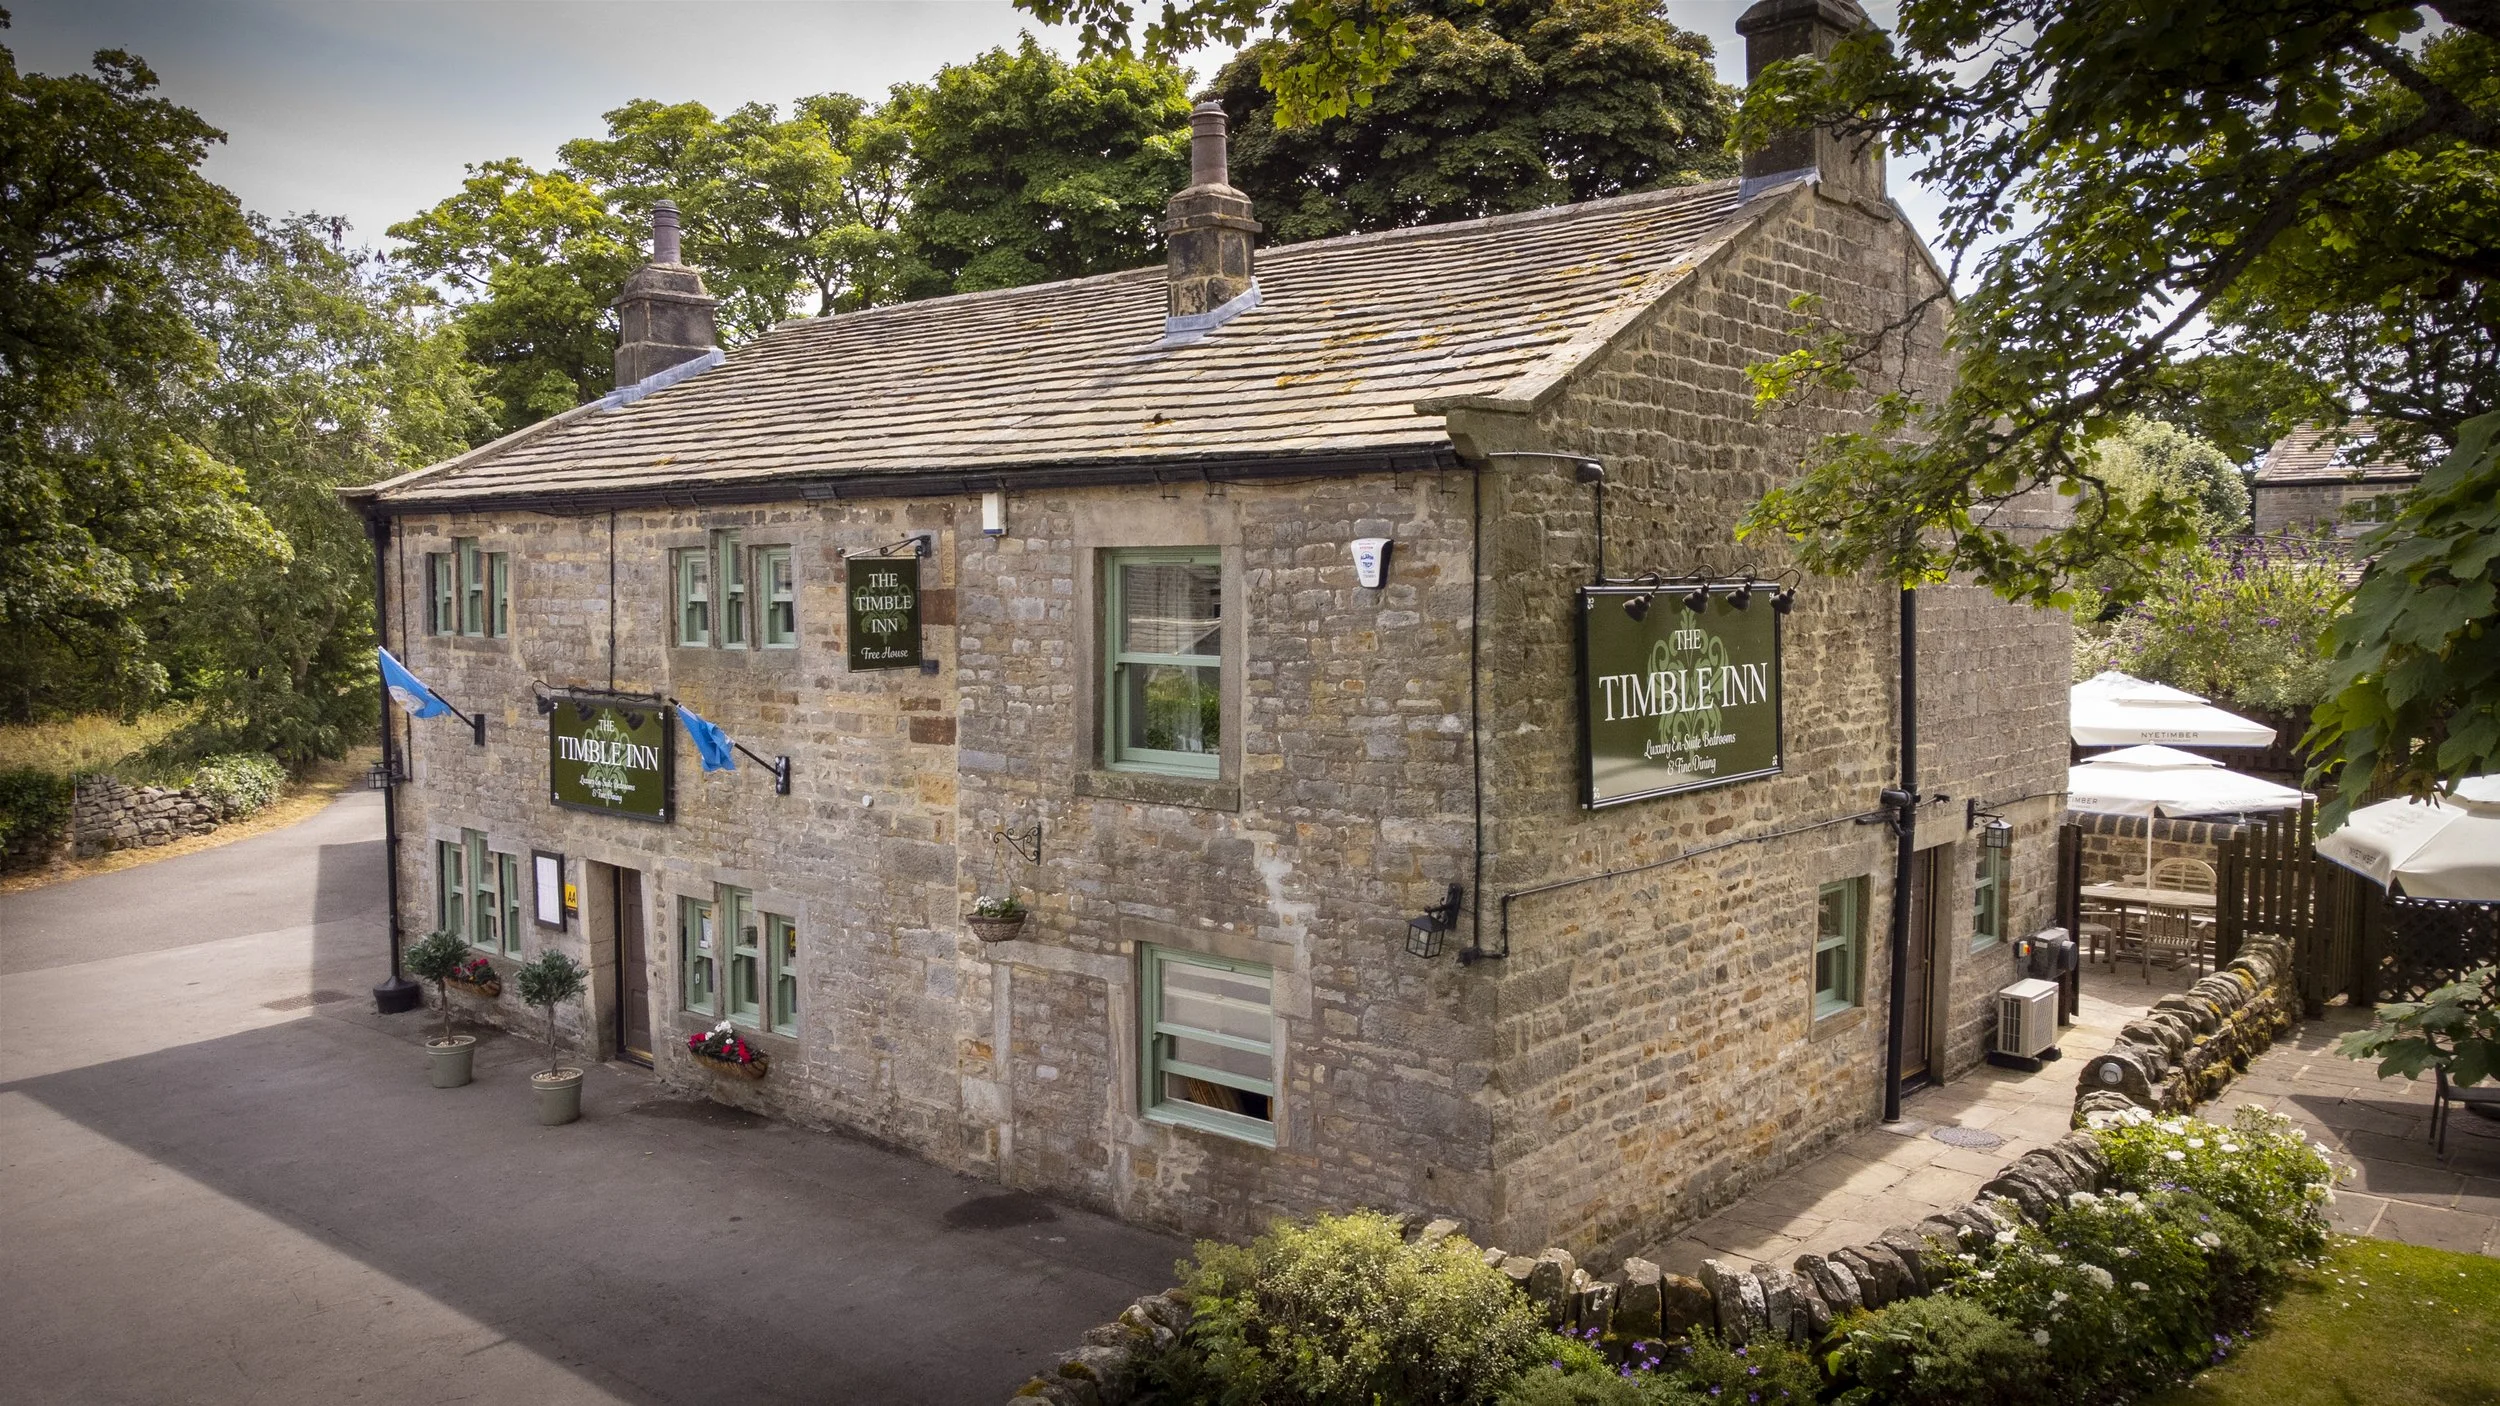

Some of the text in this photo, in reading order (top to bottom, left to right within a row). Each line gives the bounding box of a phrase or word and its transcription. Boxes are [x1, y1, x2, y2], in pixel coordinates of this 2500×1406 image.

[868, 573, 899, 588] THE
[855, 595, 913, 612] TIMBLE
[871, 618, 898, 634] INN
[1674, 629, 1701, 651] THE
[860, 646, 908, 660] Free House
[1598, 662, 1768, 722] TIMBLE INN
[598, 719, 615, 732] THE
[2141, 731, 2199, 739] NYETIMBER
[1644, 739, 1672, 759] Luxury
[1703, 730, 1736, 747] Bedrooms
[558, 735, 660, 772] TIMBLE INN
[1667, 754, 1716, 776] & Fine Dining
[567, 891, 576, 903] AA
